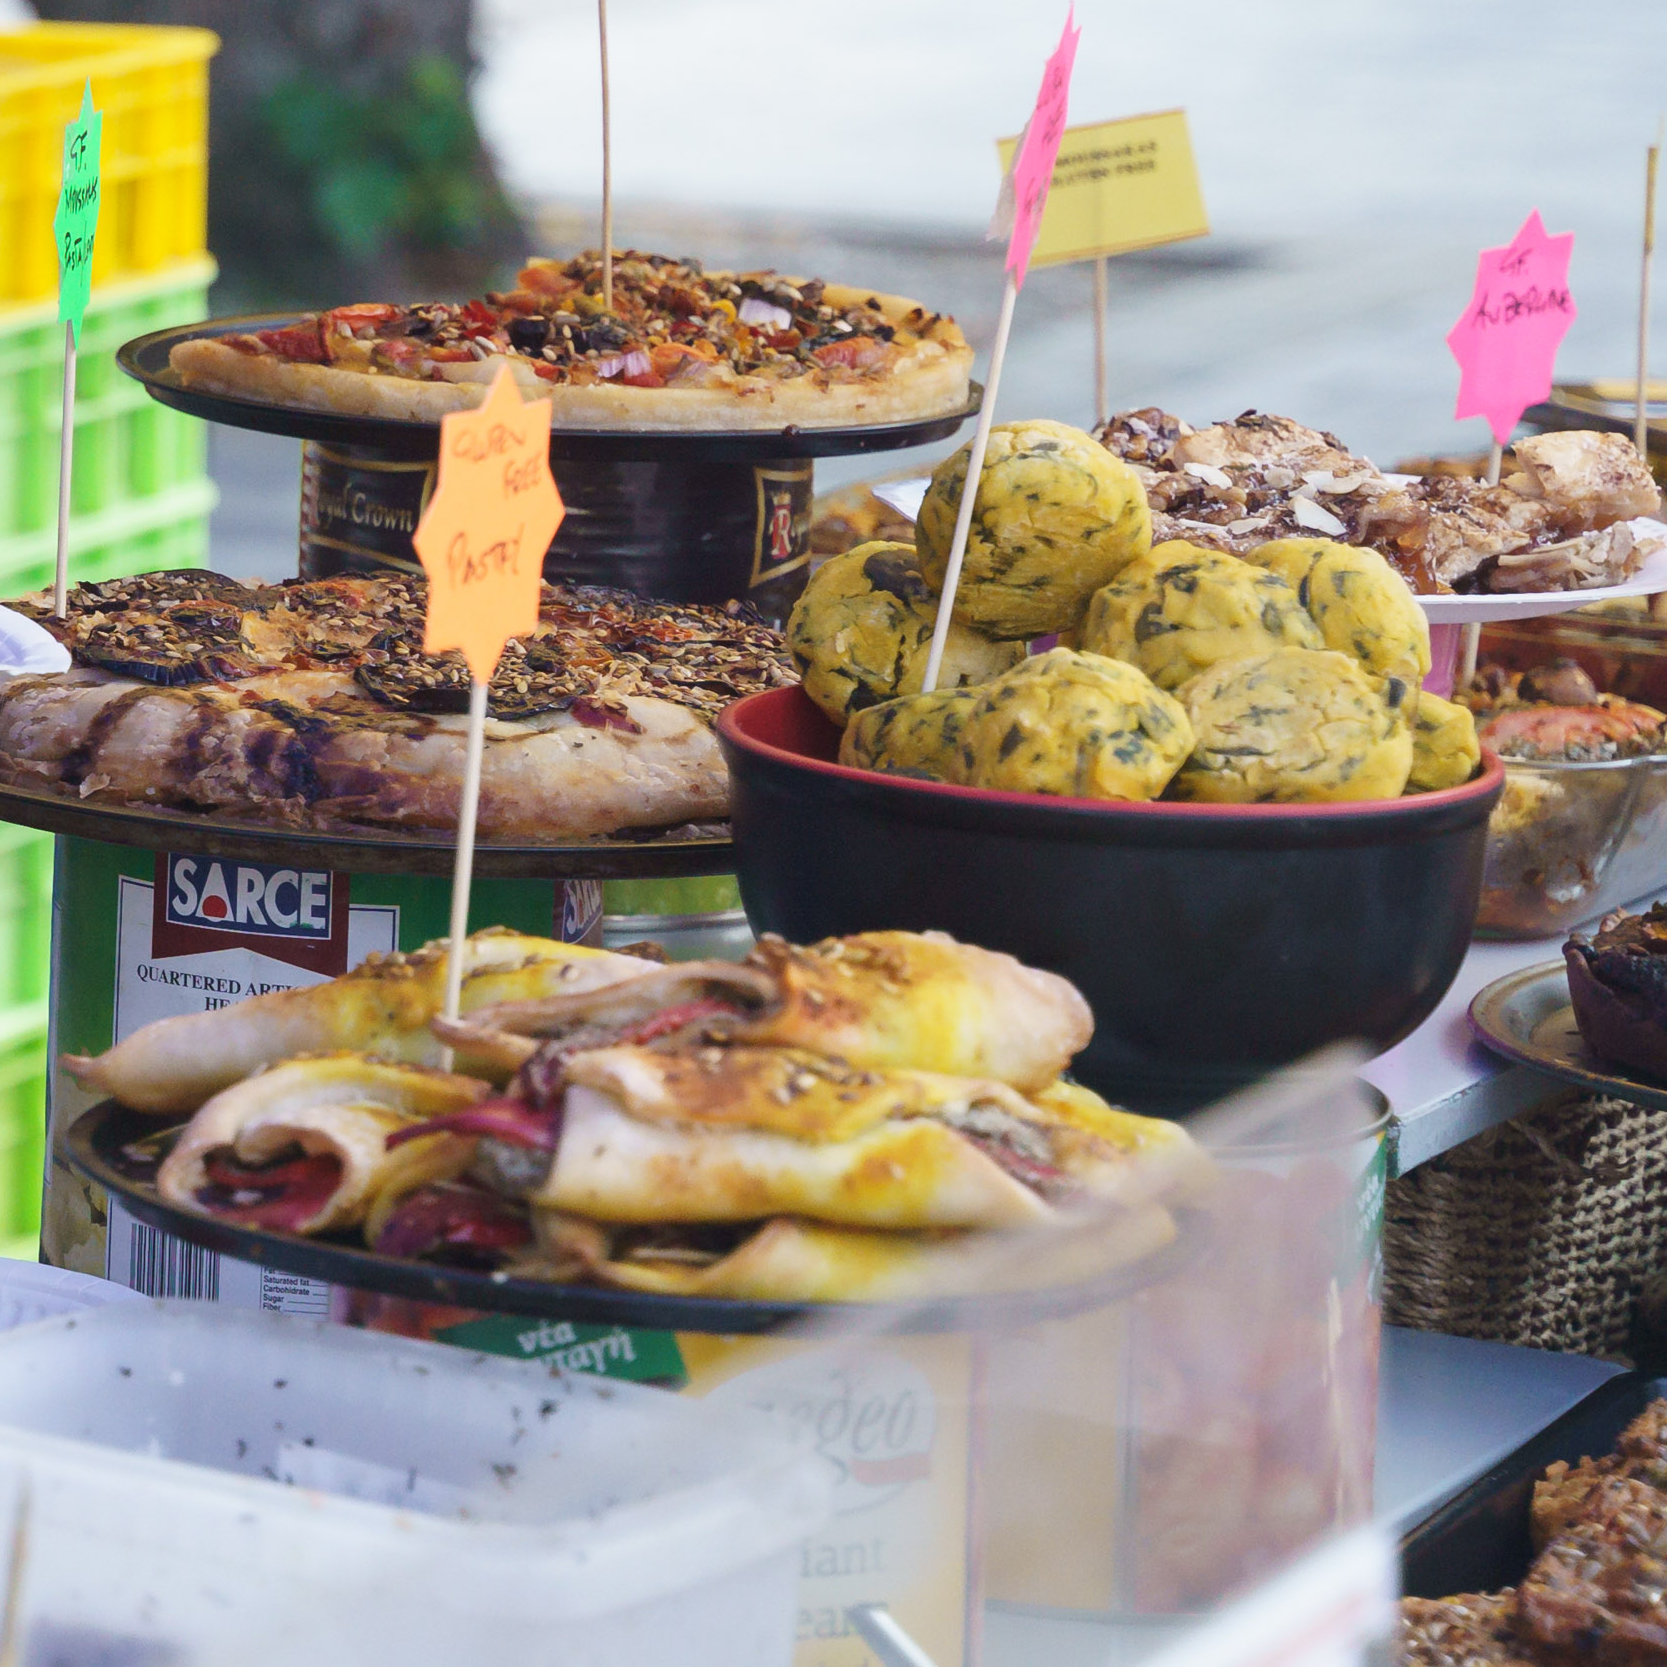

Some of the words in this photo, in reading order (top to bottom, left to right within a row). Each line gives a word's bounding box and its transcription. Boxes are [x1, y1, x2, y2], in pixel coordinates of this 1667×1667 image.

[351, 492, 415, 533] Crown
[171, 858, 328, 930] SARCE
[136, 963, 242, 995] QUARTERED
[263, 1275, 299, 1286] Saturated
[262, 1293, 285, 1304] Sugar
[262, 1302, 282, 1313] Fiber
[797, 1536, 887, 1579] iant
